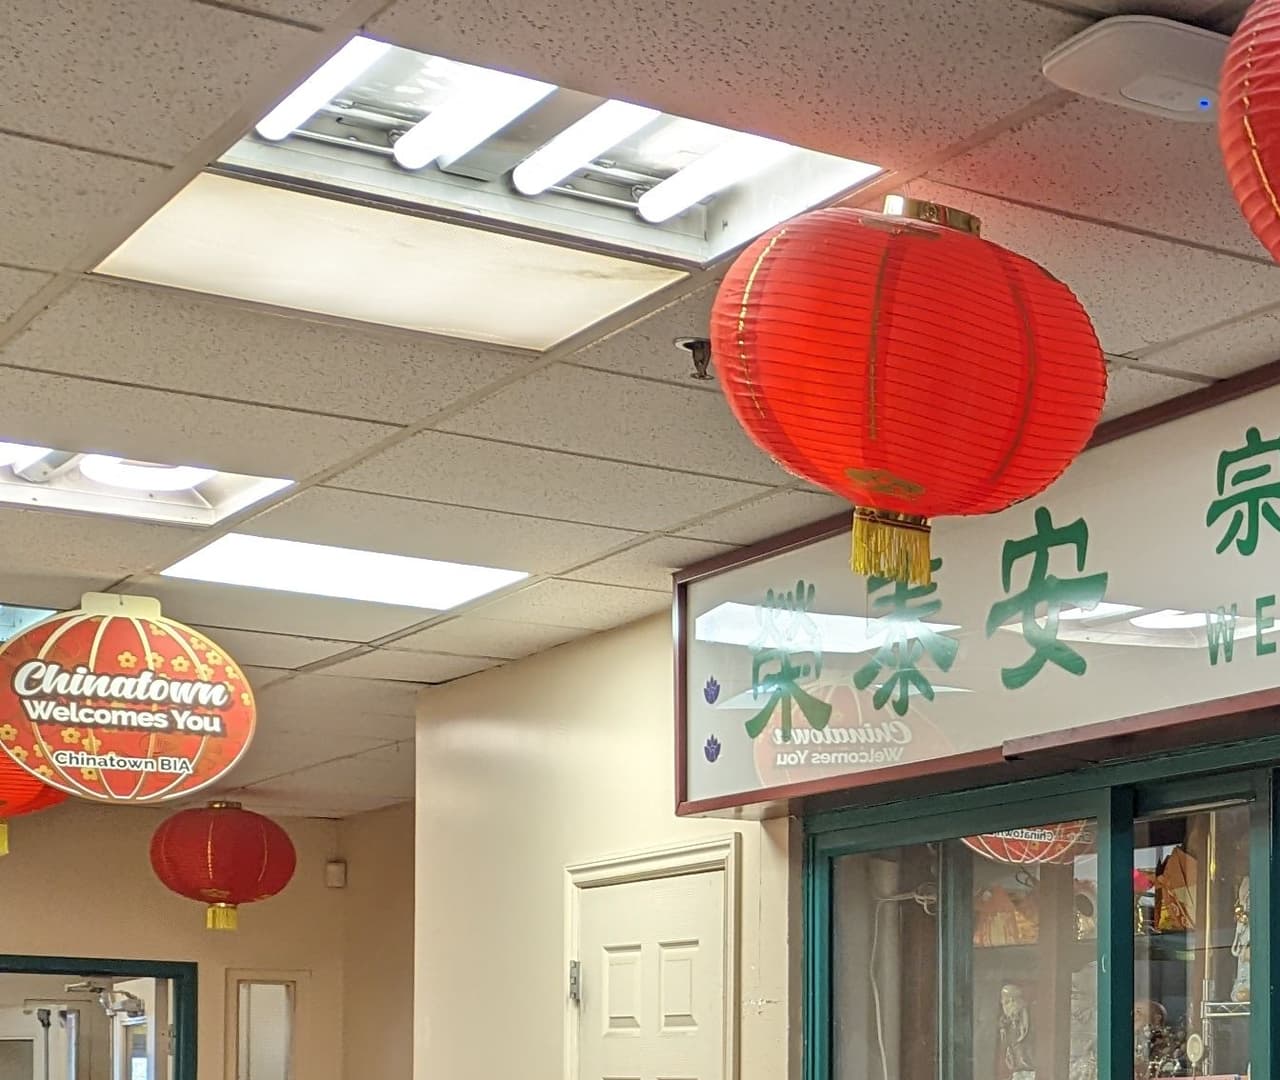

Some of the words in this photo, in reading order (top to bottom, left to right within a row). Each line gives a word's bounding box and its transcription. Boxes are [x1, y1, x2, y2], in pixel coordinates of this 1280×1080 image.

[14, 660, 229, 707] Chinatown
[23, 699, 169, 728] Welcomes
[171, 709, 222, 734] You
[54, 751, 155, 771] Chinatown
[160, 756, 192, 773] BIA
